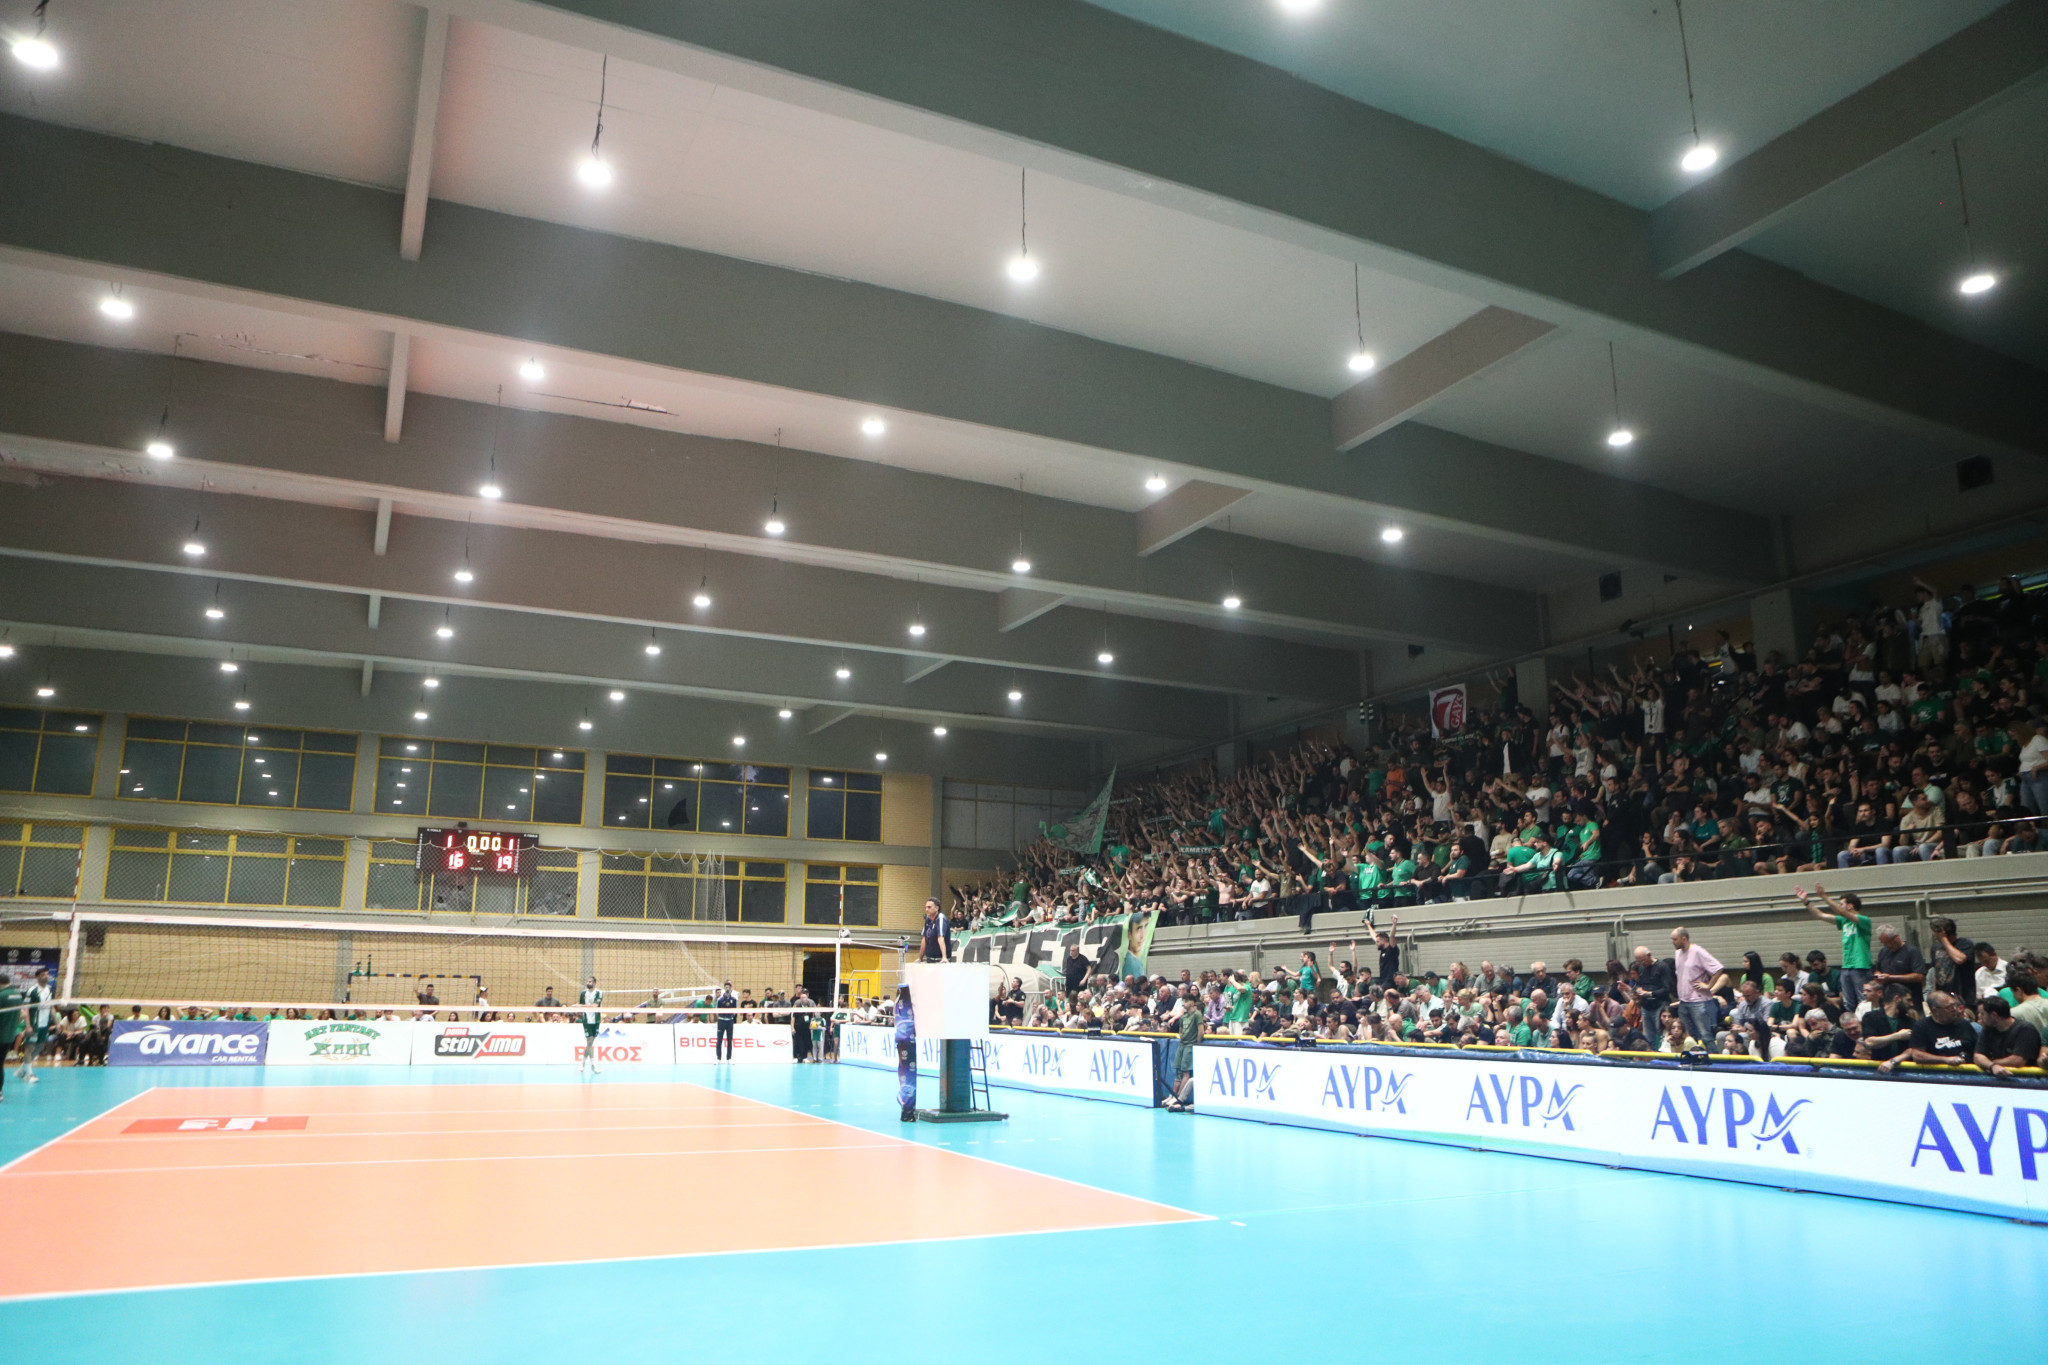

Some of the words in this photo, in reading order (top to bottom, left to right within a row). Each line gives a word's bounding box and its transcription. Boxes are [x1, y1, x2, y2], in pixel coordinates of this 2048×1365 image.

[447, 835, 453, 848] 1
[508, 838, 514, 851] 1
[449, 853, 464, 868] 16
[497, 855, 513, 869] 19
[139, 1033, 260, 1055] avance
[679, 1037, 766, 1048] BIOSTEEL
[211, 1055, 228, 1063] CAR
[228, 1055, 257, 1063] RENTAL
